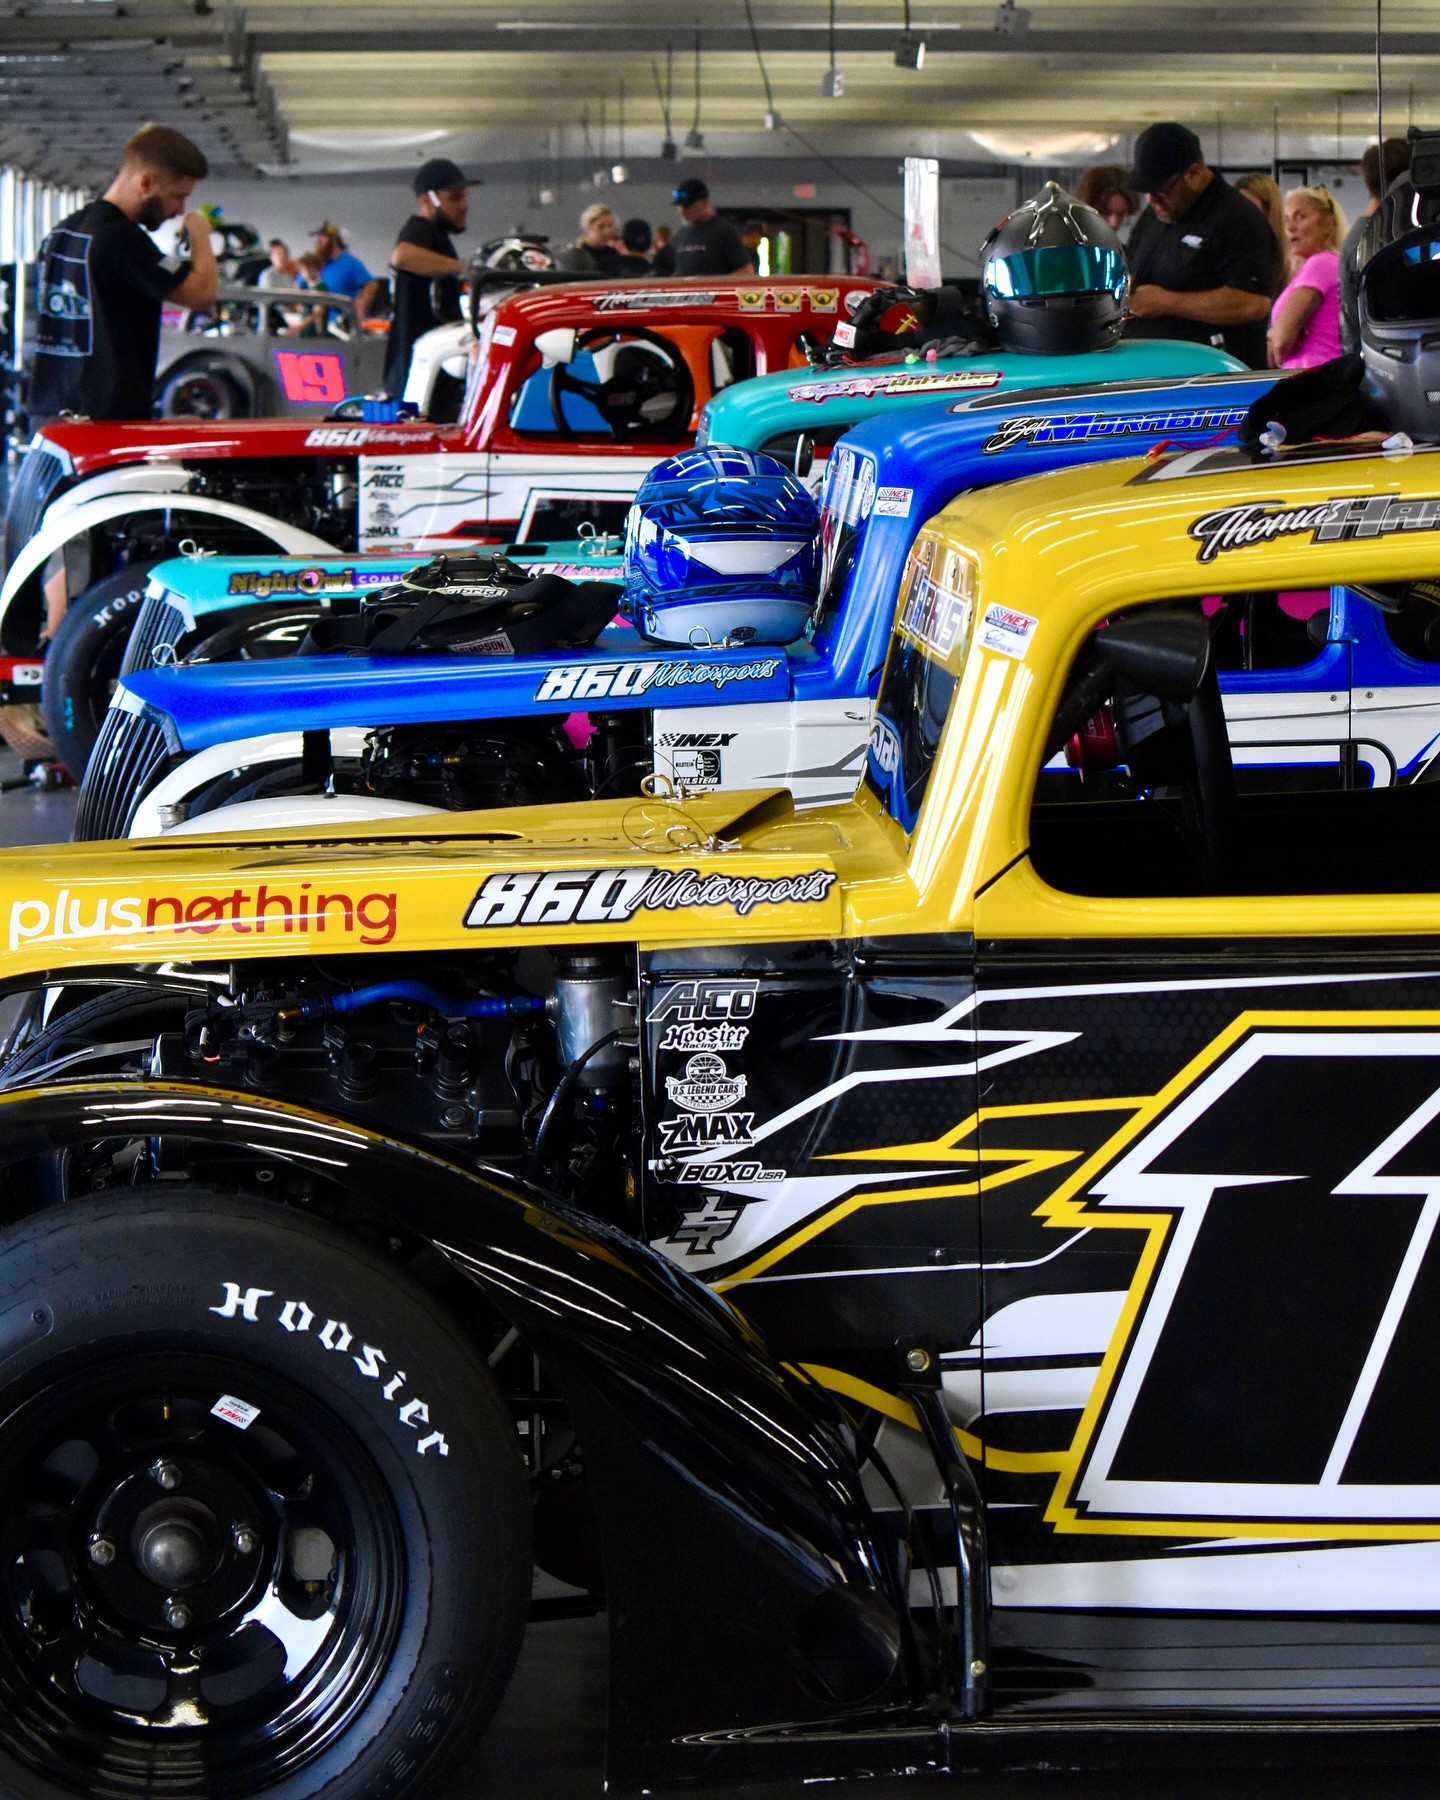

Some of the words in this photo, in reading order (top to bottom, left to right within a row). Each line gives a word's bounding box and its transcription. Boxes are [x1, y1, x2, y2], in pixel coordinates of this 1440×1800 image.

[274, 351, 347, 402] 19
[1191, 501, 1347, 561] Thomas
[1001, 612, 1031, 629] INEX
[533, 660, 662, 702] 860
[641, 659, 783, 690] Motorsports
[671, 732, 740, 748] INEX
[464, 867, 656, 928] 860
[626, 868, 837, 915] Motorsports
[646, 980, 760, 1022] AFCO
[660, 1024, 749, 1049] Hoosier
[682, 1042, 717, 1050] Racing
[687, 1085, 717, 1095] LEGEND
[717, 1084, 740, 1094] CARS
[681, 1163, 761, 1182] BOXO
[757, 1171, 784, 1180] USA
[208, 1282, 449, 1458] Hoosier
